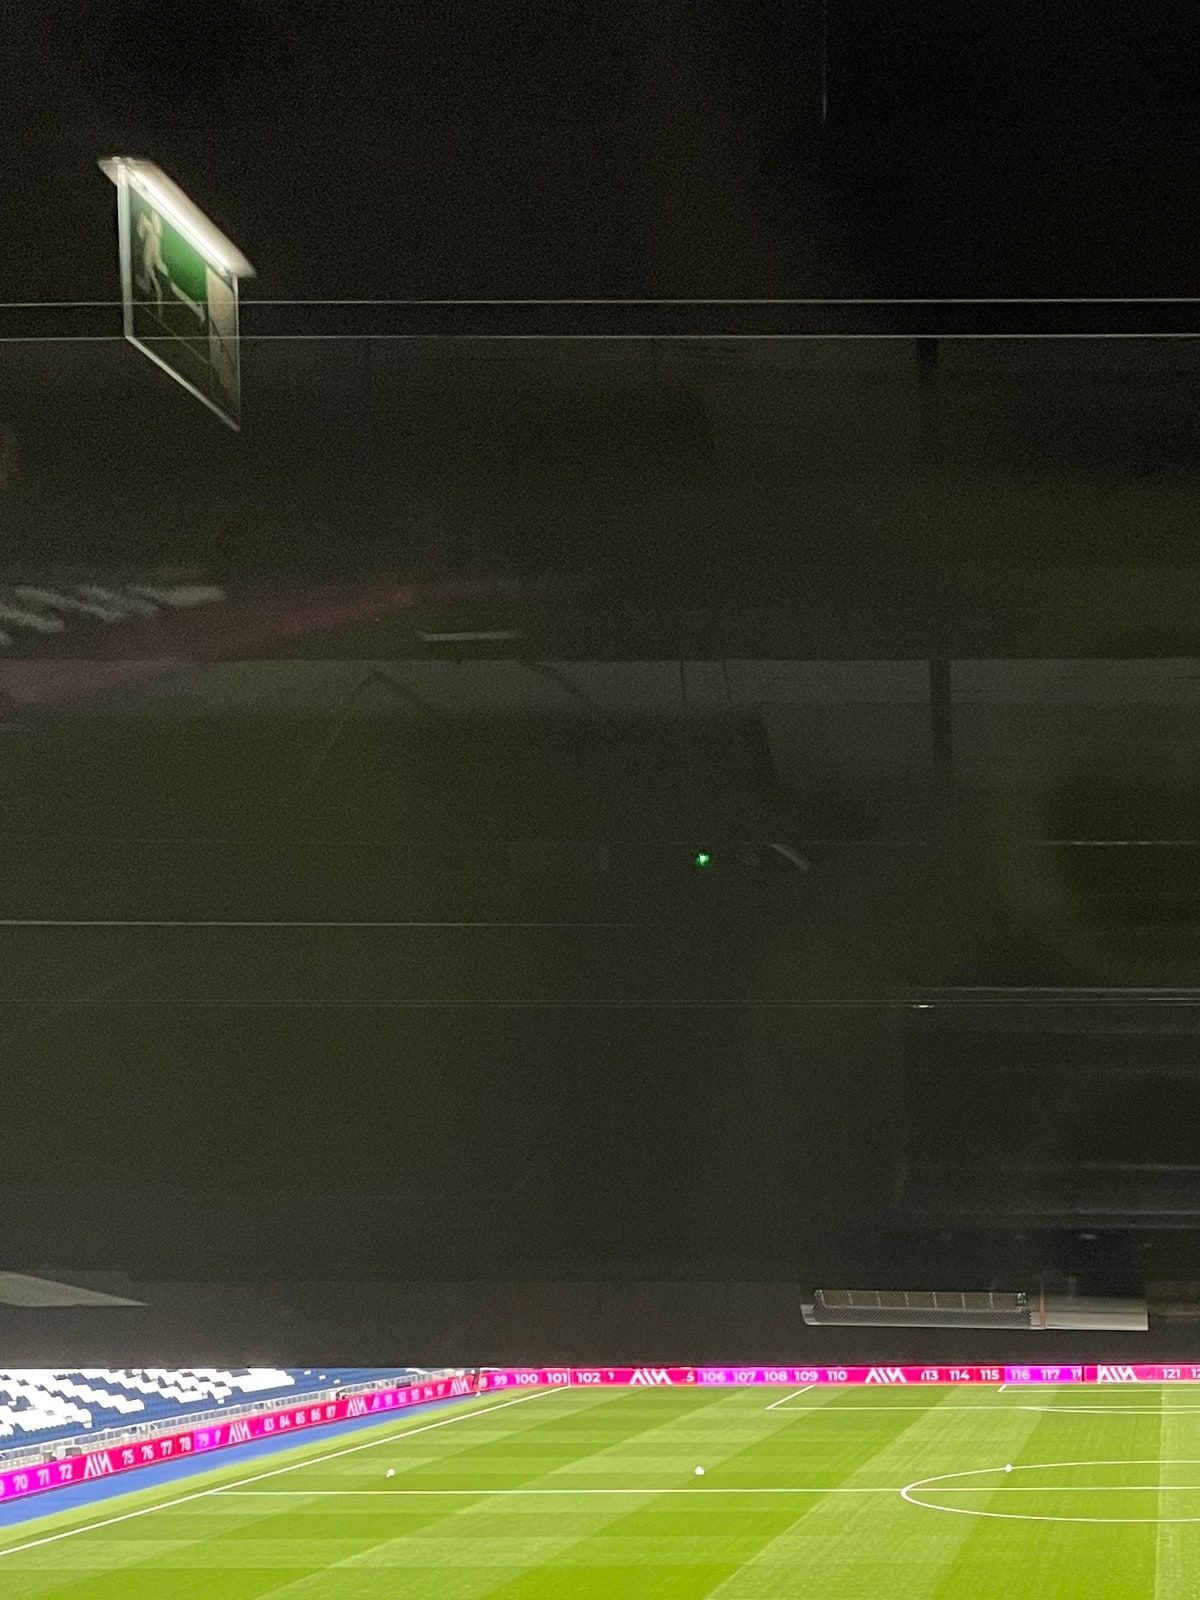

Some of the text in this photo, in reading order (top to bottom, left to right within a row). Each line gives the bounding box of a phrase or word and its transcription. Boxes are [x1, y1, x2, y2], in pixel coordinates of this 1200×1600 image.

[494, 1375, 508, 1385] 99
[514, 1373, 539, 1384] 100
[547, 1373, 568, 1383] 101
[577, 1372, 601, 1383] 102
[702, 1371, 726, 1382] 106
[732, 1371, 756, 1381] 107
[763, 1371, 788, 1381] 108
[794, 1371, 819, 1381] 109
[826, 1370, 848, 1381] 110
[949, 1370, 970, 1380] 114
[980, 1370, 1000, 1380] 115
[1010, 1369, 1030, 1380] 116
[1041, 1370, 1061, 1380] 117
[1162, 1369, 1181, 1379] 121
[13, 1474, 28, 1492] 70
[37, 1469, 50, 1485] 71
[59, 1464, 73, 1480] 72
[122, 1450, 134, 1466] 75
[141, 1445, 154, 1460] 76
[160, 1440, 173, 1456] 77
[179, 1436, 192, 1452] 78
[279, 1415, 291, 1428] 84
[295, 1411, 306, 1425] 85
[310, 1408, 321, 1421] 86
